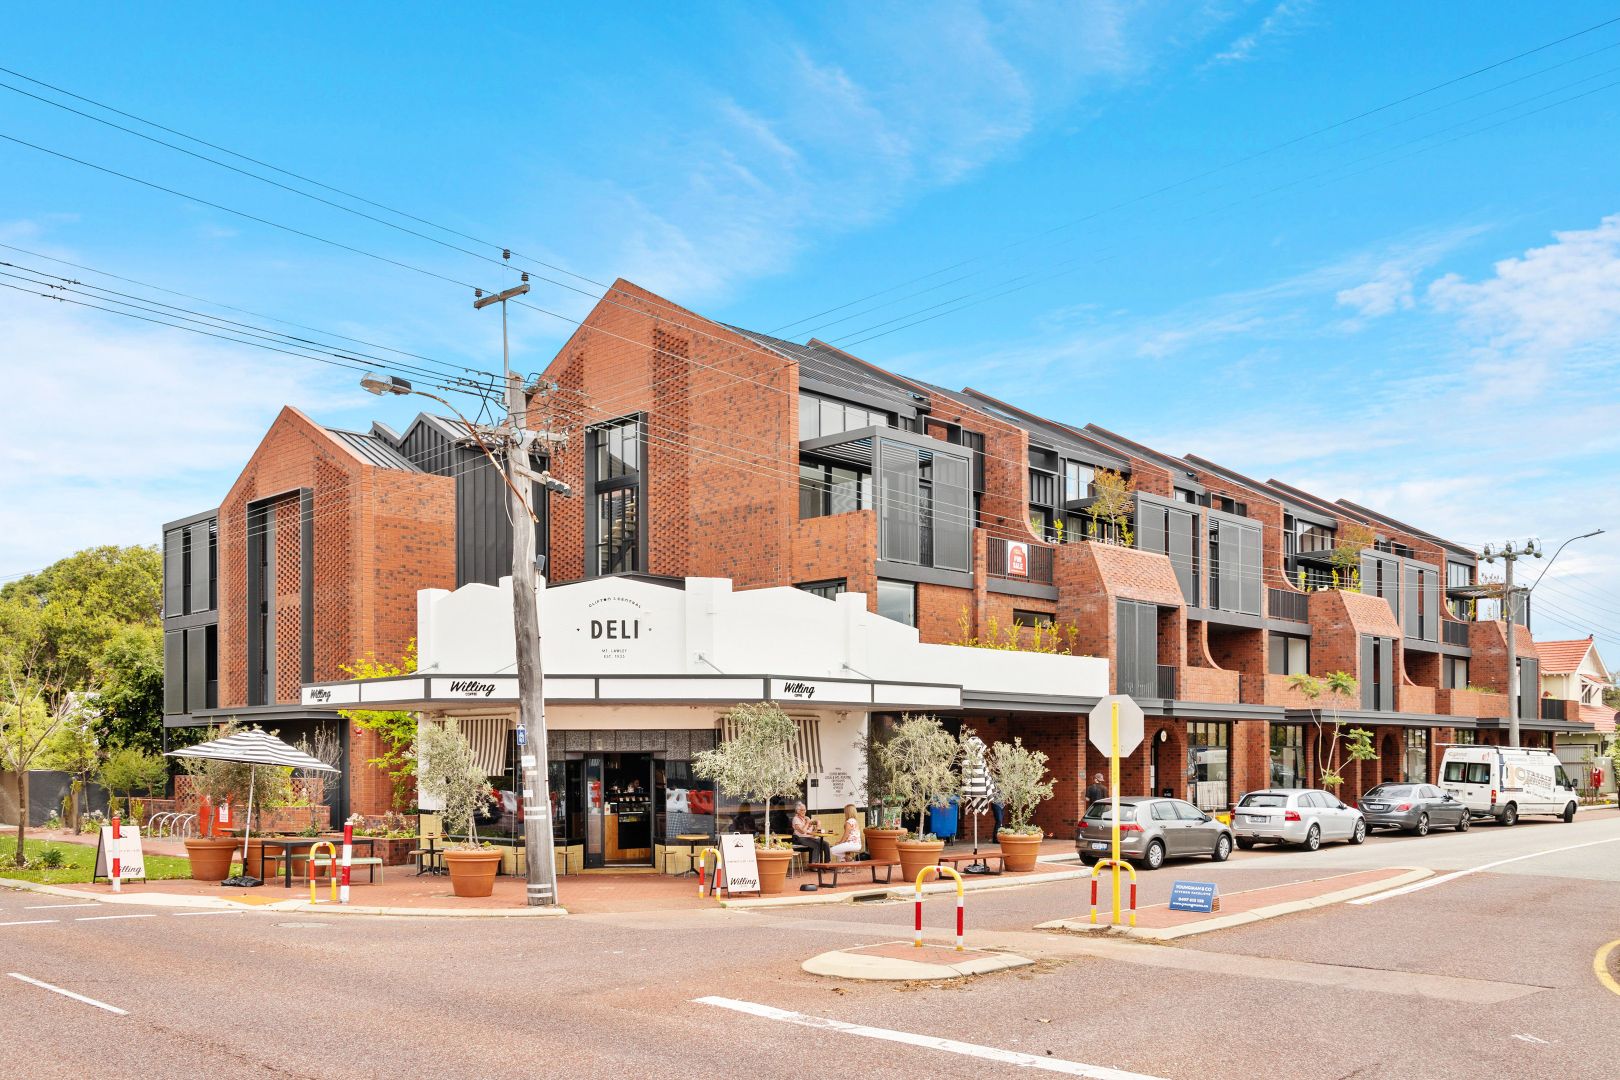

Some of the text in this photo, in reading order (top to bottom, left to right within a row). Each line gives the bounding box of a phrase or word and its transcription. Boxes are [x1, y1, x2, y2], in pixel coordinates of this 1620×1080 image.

[591, 619, 639, 640] DELI
[310, 688, 331, 702] Willing
[450, 680, 496, 697] Willing
[784, 682, 816, 699] Willing
[730, 877, 757, 889] Willing
